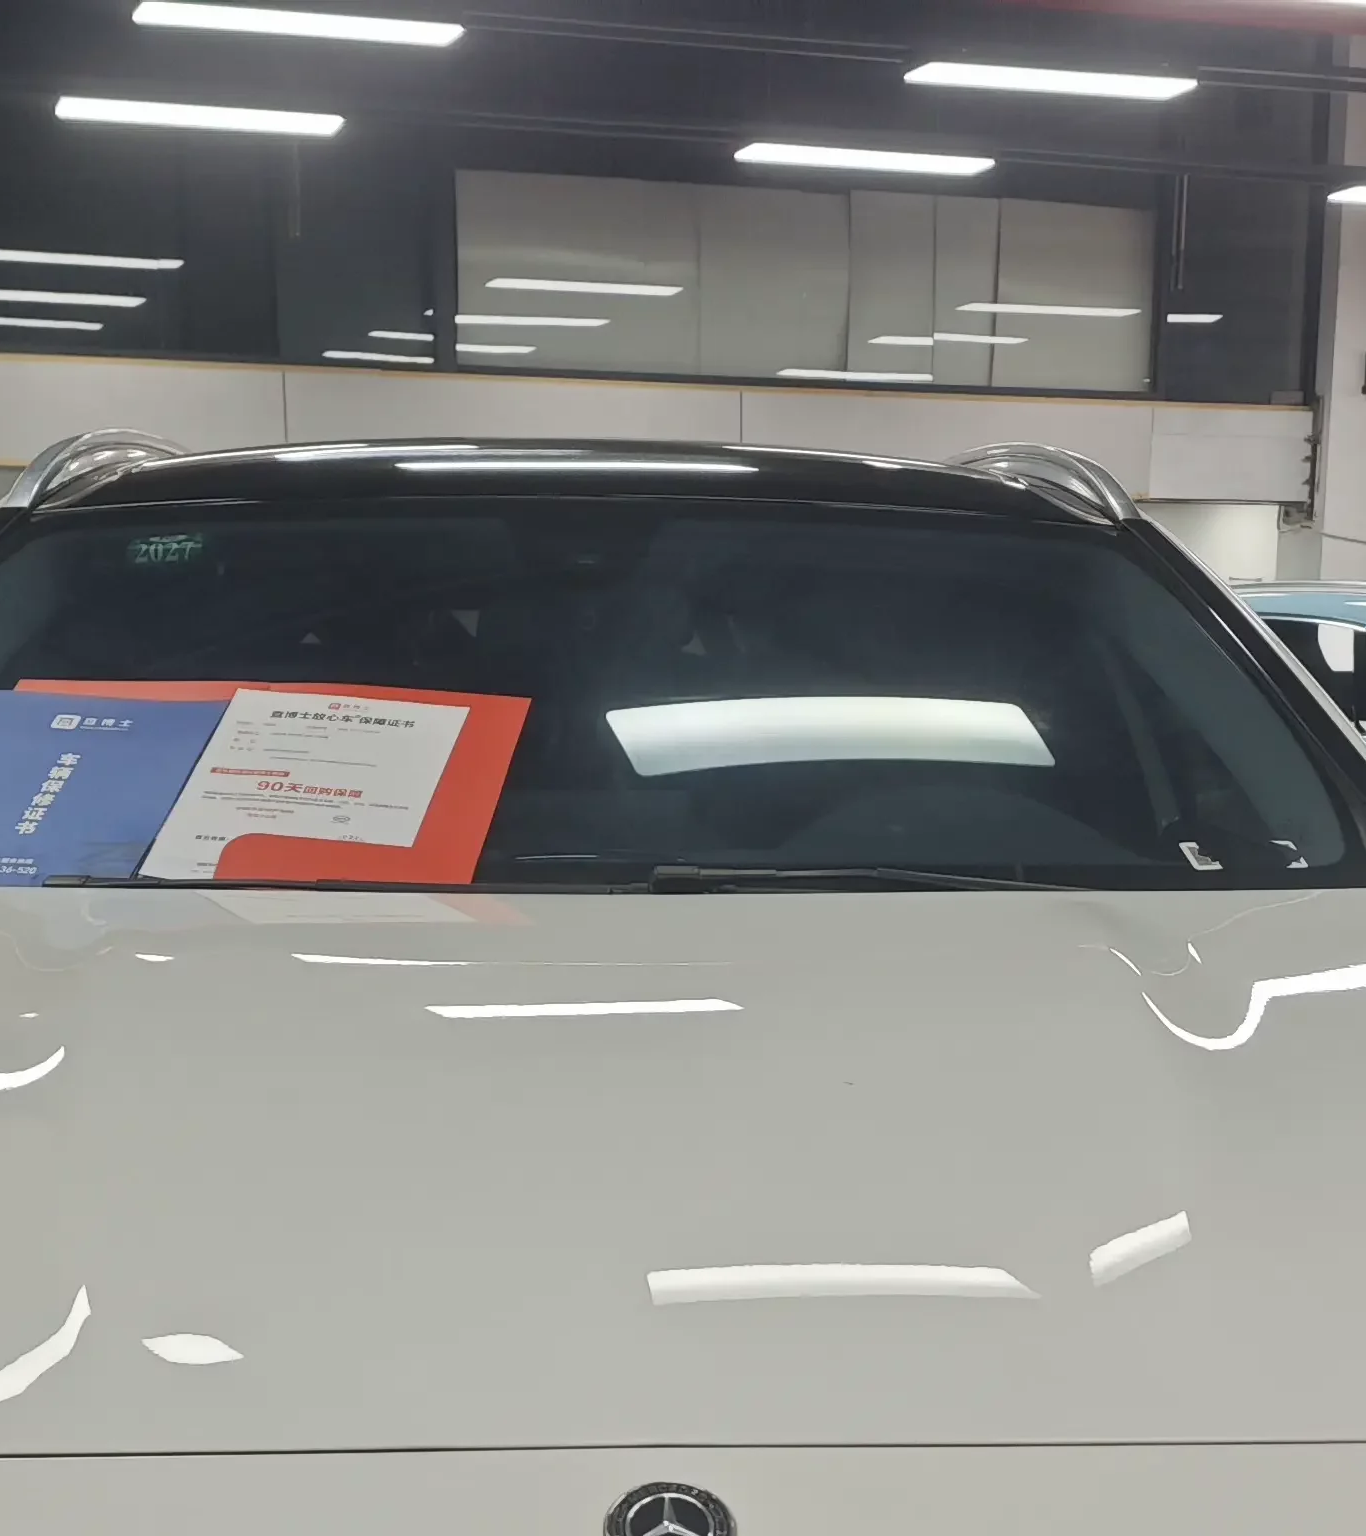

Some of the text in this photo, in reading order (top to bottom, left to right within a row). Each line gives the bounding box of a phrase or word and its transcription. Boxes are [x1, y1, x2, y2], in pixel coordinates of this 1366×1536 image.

[135, 541, 196, 564] 2027
[15, 753, 81, 835] 车辆保修证书
[255, 780, 364, 799] 90天回购保障
